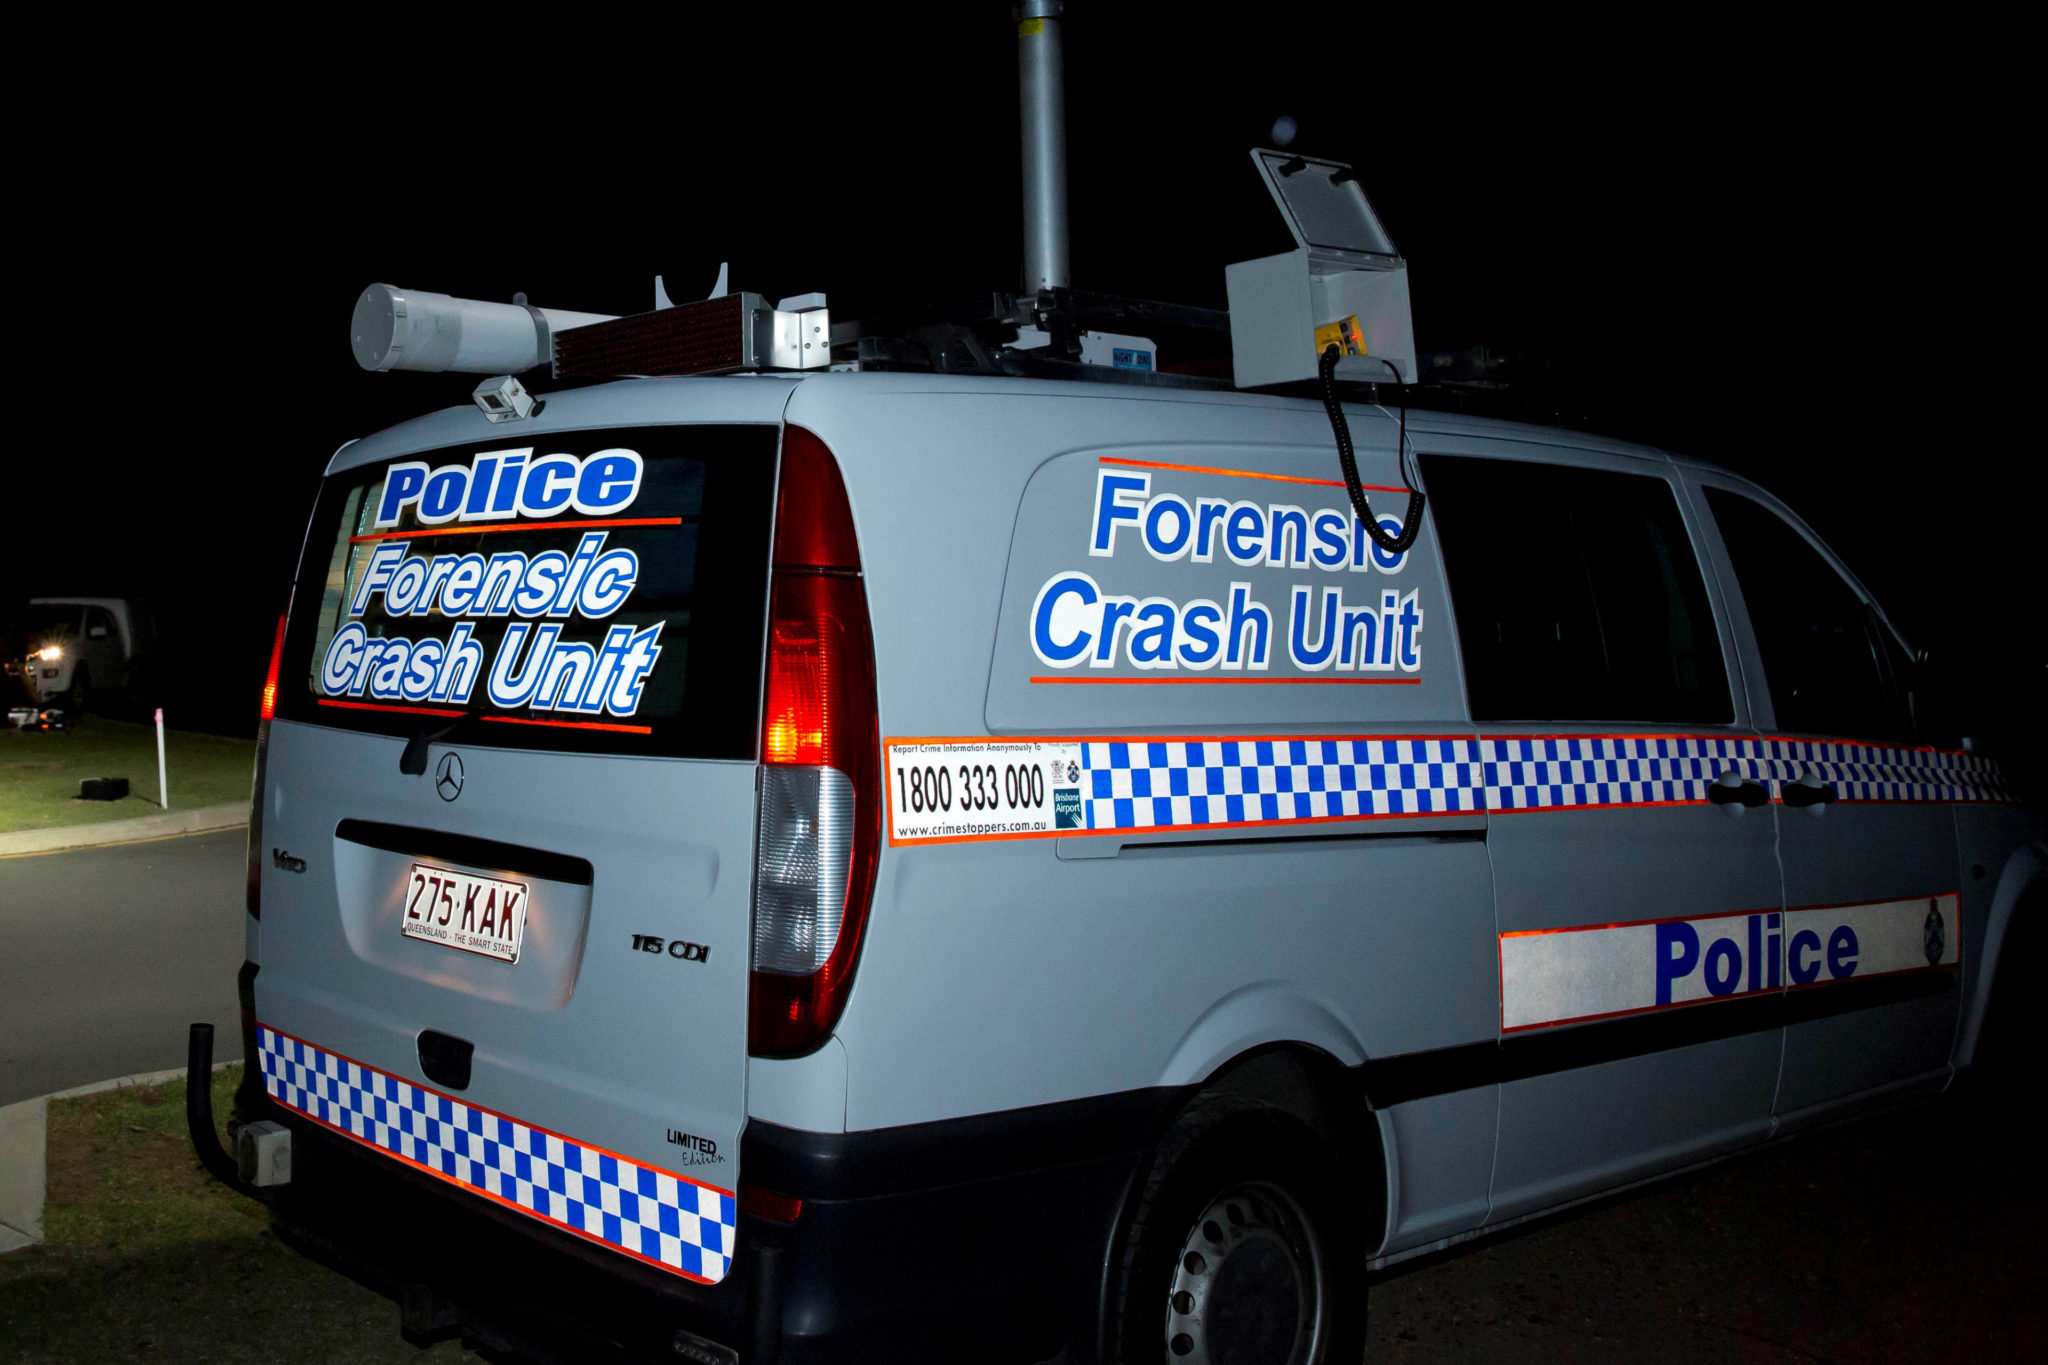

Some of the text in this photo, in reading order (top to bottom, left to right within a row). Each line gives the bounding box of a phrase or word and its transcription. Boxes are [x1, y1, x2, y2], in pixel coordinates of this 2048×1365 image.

[374, 447, 644, 528] Police
[1089, 468, 1409, 575] Forensic
[349, 531, 639, 619] Forensic
[1030, 571, 1424, 672] Crash Unit
[321, 620, 666, 717] Crash Unit
[893, 744, 918, 756] Report
[920, 743, 941, 753] Crime
[944, 743, 985, 753] Information
[986, 743, 1031, 754] Anonymously
[1034, 742, 1042, 751] To
[897, 763, 1044, 813] 1800 333 000
[1055, 792, 1080, 802] Brisbane
[898, 821, 1047, 837] www.crimestoppers.com.au
[1055, 803, 1081, 815] Airport
[406, 922, 447, 939] QUEENSLAND
[454, 933, 466, 944] THE
[468, 937, 491, 950] SMART
[493, 943, 513, 954] STATE
[668, 940, 710, 963] CDI
[1655, 912, 1859, 1005] Police
[667, 1128, 717, 1155] LIMITED
